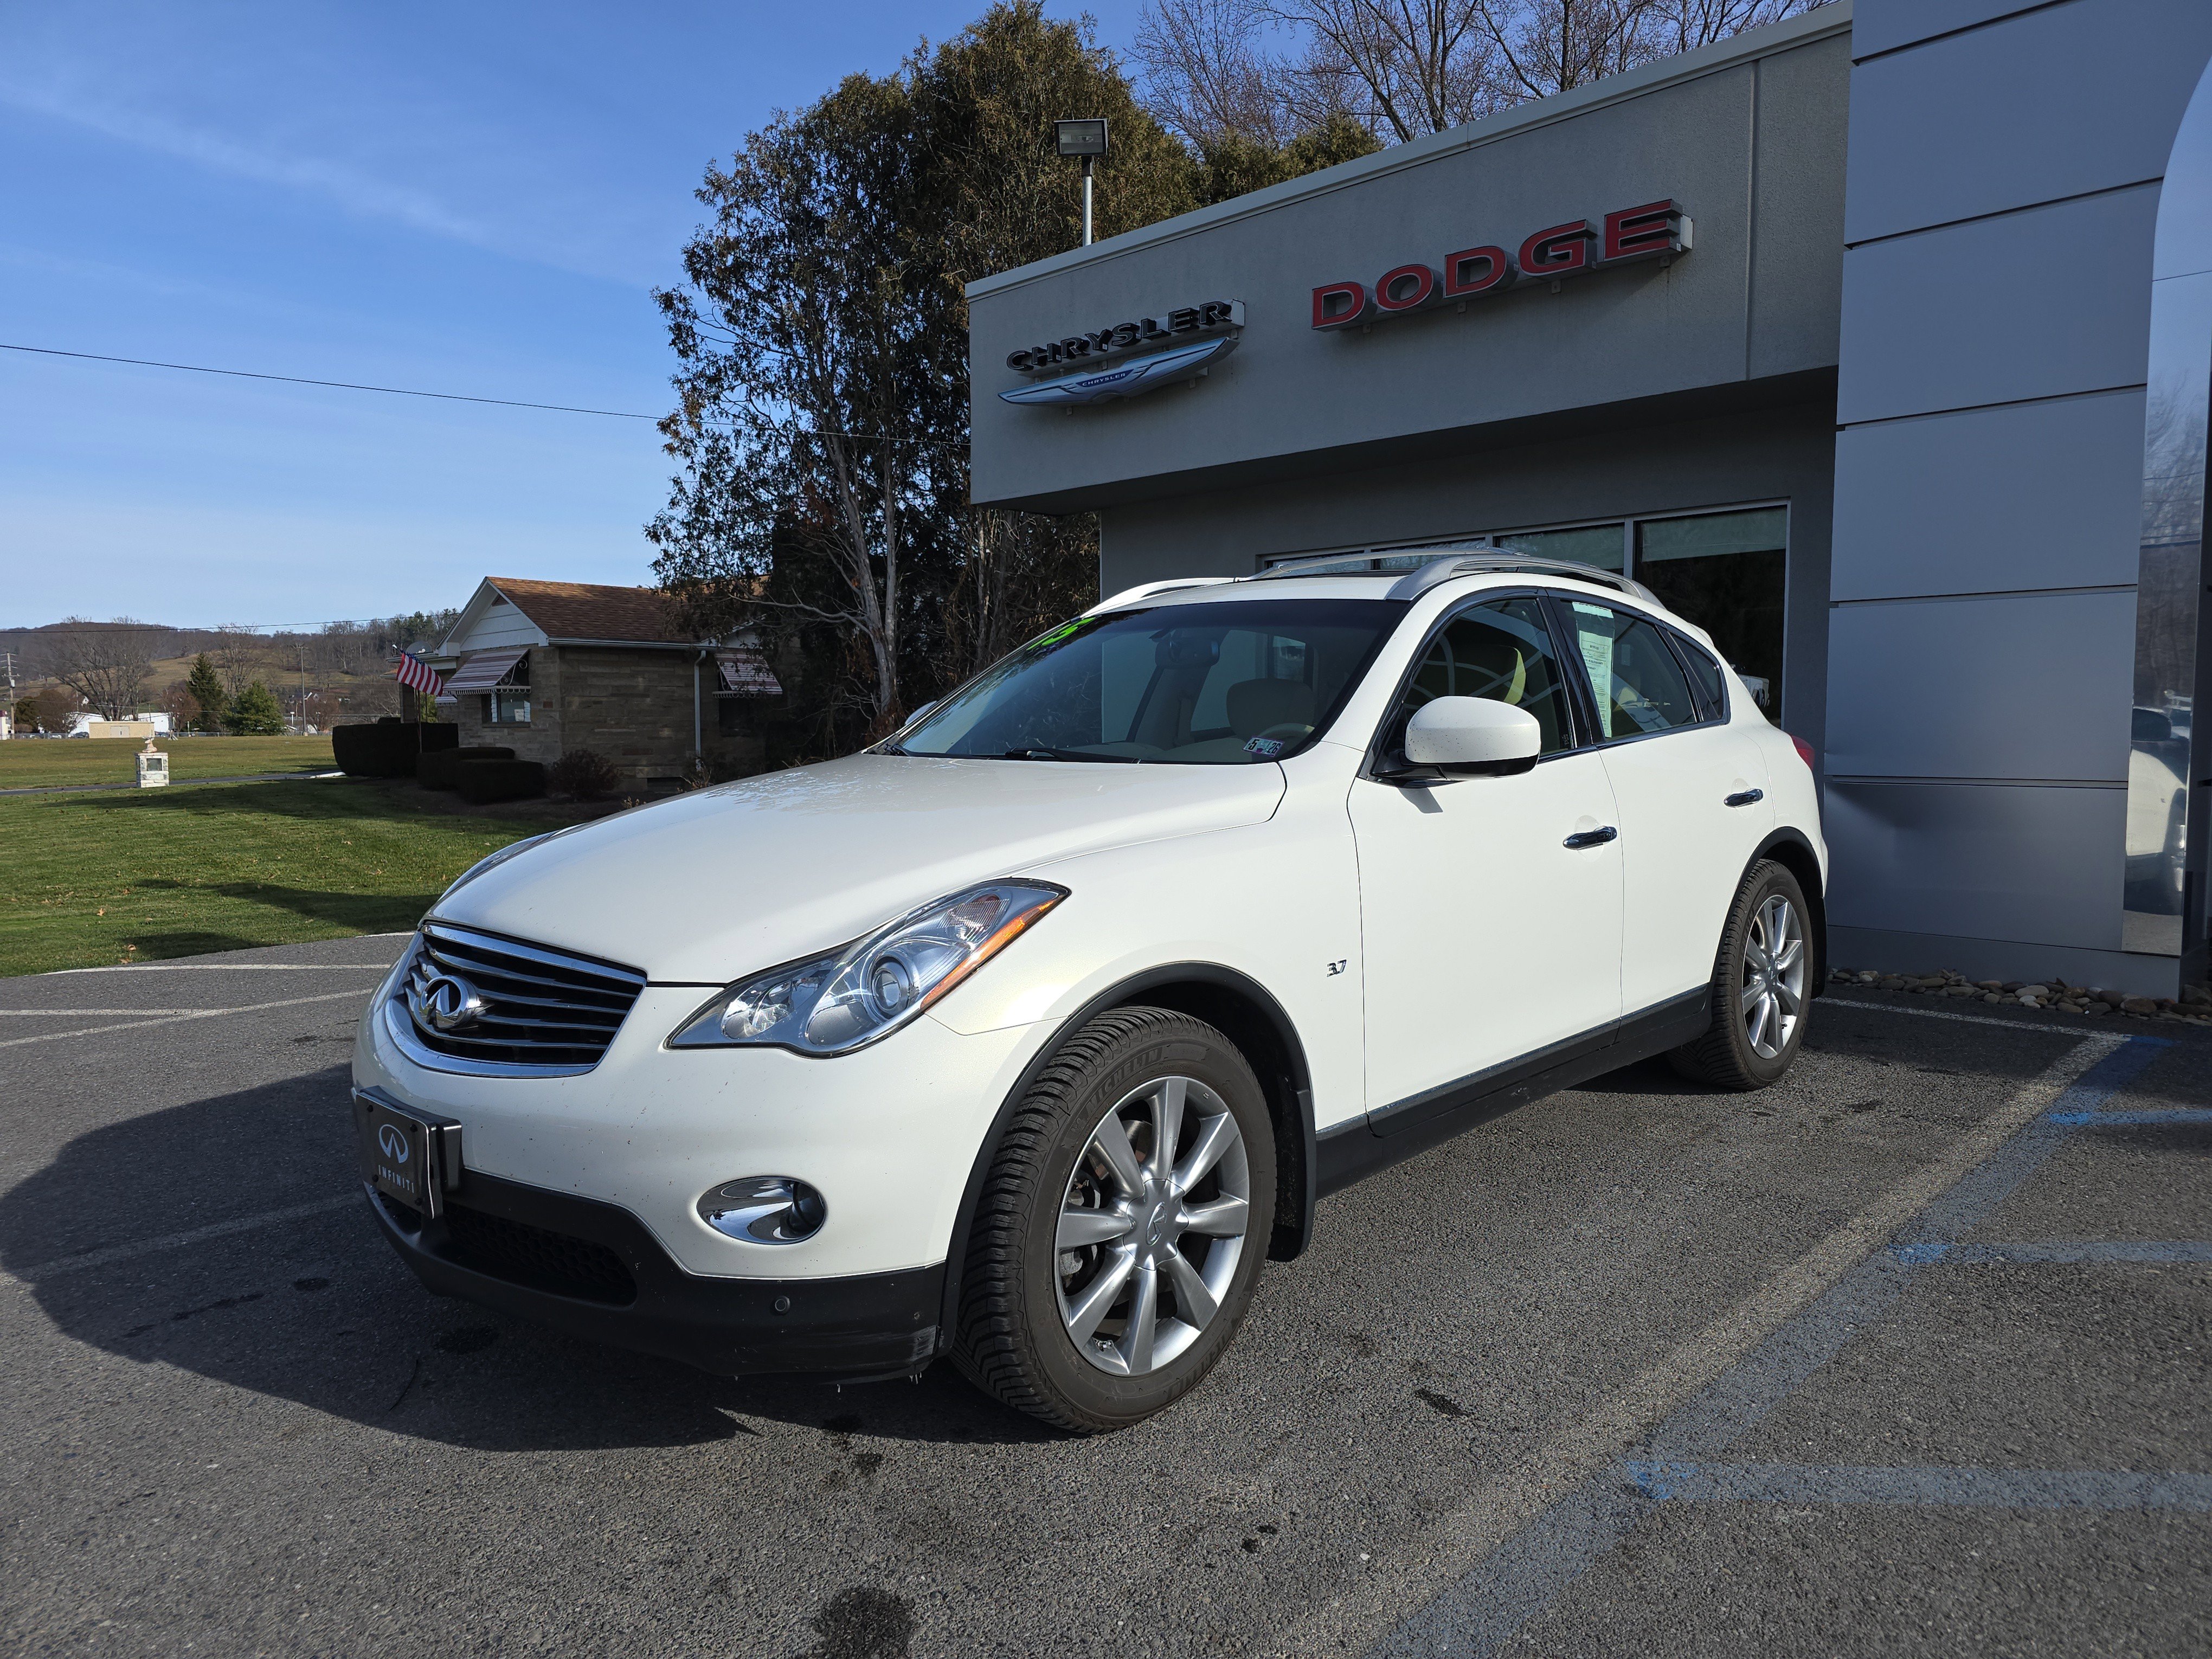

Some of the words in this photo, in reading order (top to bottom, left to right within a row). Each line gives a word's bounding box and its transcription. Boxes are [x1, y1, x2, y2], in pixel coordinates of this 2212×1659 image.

[1312, 198, 1681, 329] DODGE
[1007, 301, 1232, 371] CHRYSLER
[1082, 373, 1126, 386] CHRYSLER
[1267, 742, 1281, 754] 26
[1086, 1049, 1159, 1114] MICHELIN
[378, 1165, 415, 1194] INFINITI
